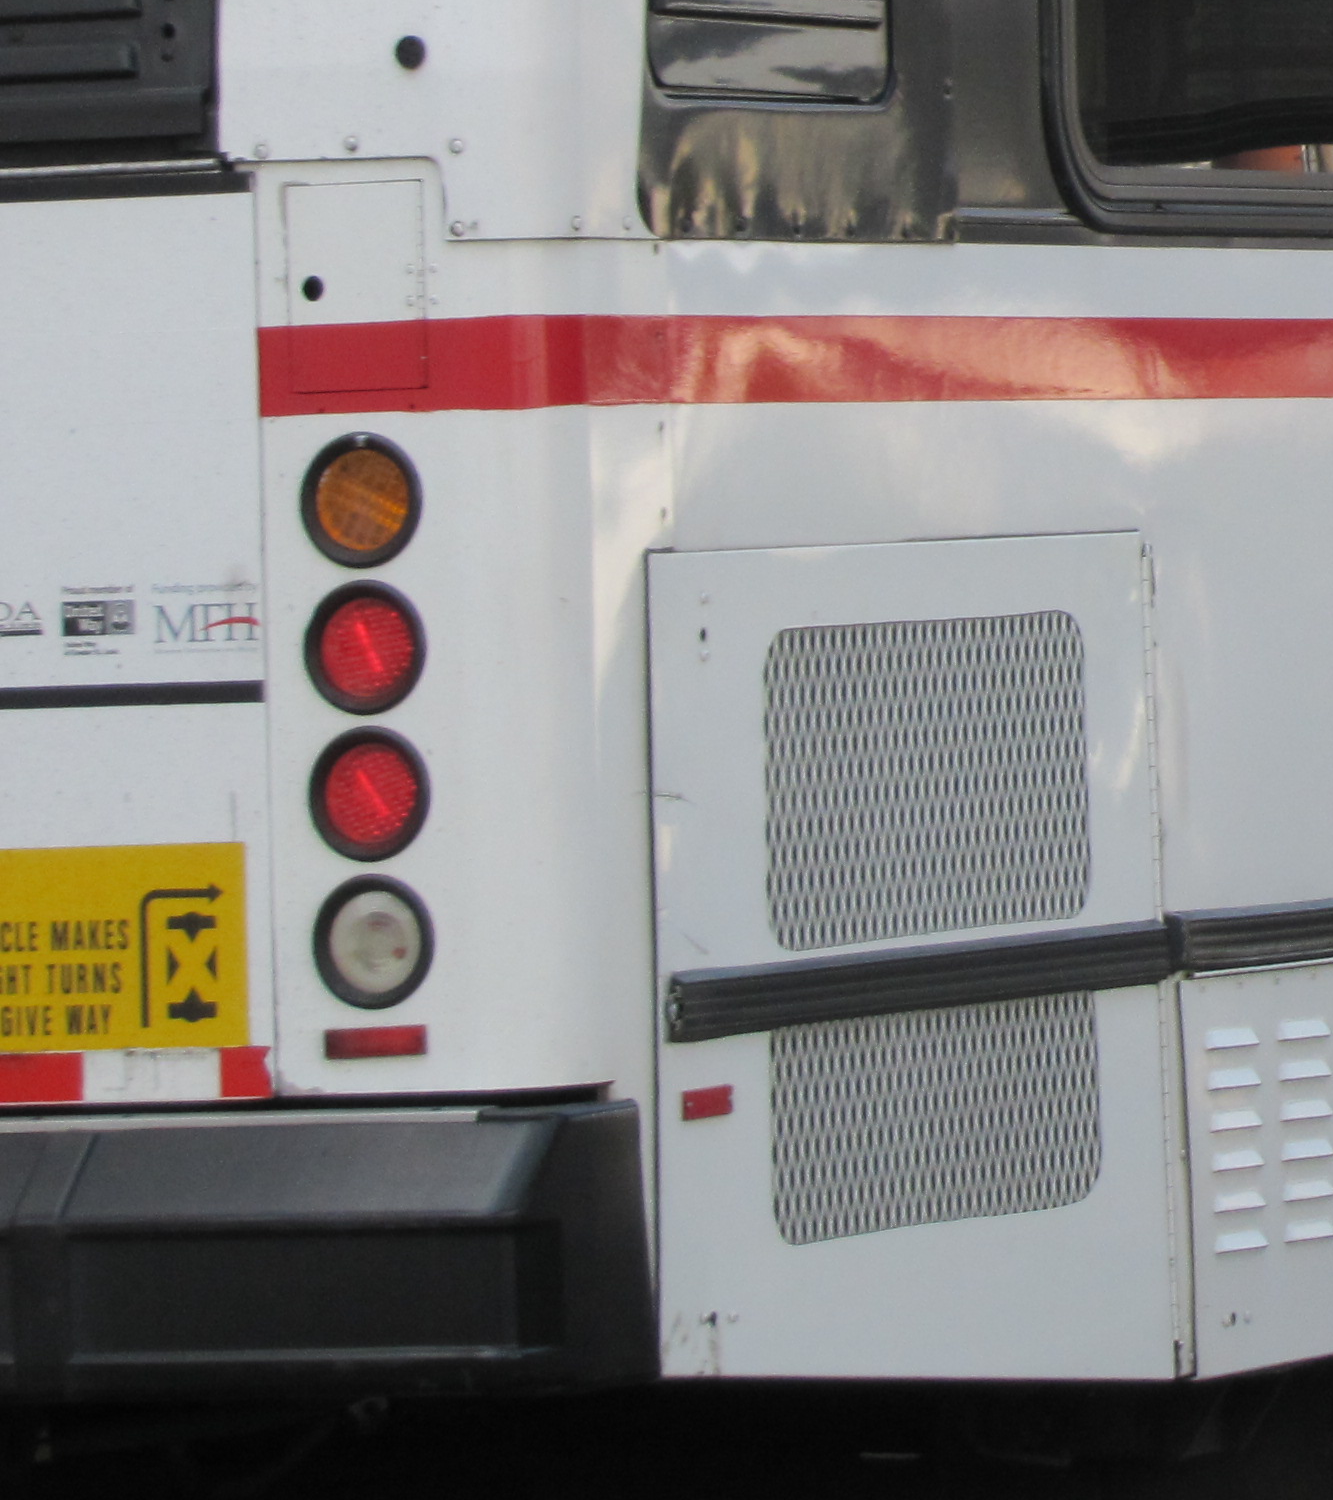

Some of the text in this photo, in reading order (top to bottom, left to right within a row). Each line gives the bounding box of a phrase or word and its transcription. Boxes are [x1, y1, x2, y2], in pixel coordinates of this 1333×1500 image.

[1, 919, 129, 952] CLE MAKES
[0, 961, 122, 994] HT TURNS
[1, 1003, 112, 1037] GIVE WAY
